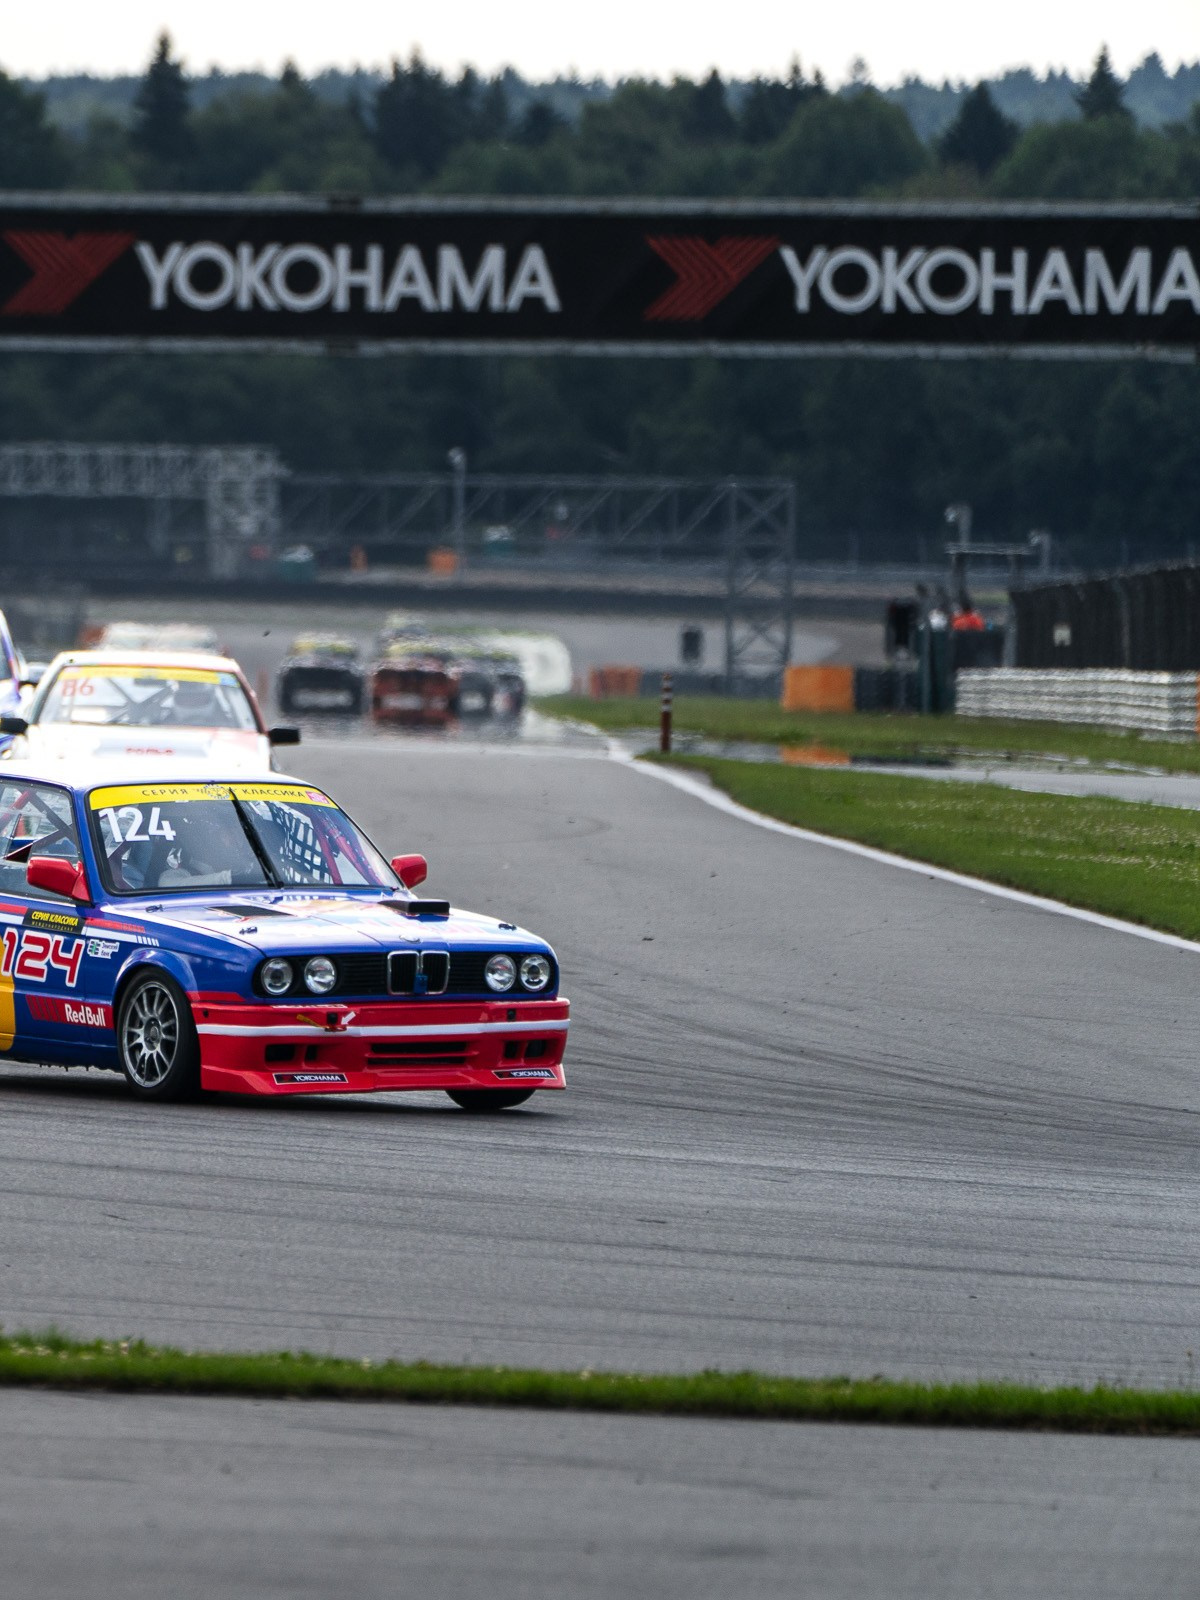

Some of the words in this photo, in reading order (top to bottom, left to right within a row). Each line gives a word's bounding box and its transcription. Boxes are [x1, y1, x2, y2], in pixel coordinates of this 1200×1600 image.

[134, 241, 562, 312] YOKOHAMA
[778, 245, 1200, 315] YOKOHAMA
[141, 788, 189, 797] СЕРИЯ
[241, 788, 306, 799] КЛАССИКА
[98, 806, 177, 843] 124
[31, 911, 50, 922] СЕРИЯ
[49, 914, 79, 927] КЛАССИКА
[1, 927, 86, 988] 124
[64, 1003, 86, 1024] Red
[85, 1006, 106, 1027] Bull
[294, 1074, 341, 1082] YOKOHAMA
[513, 1070, 553, 1079] YOKOHAMA
